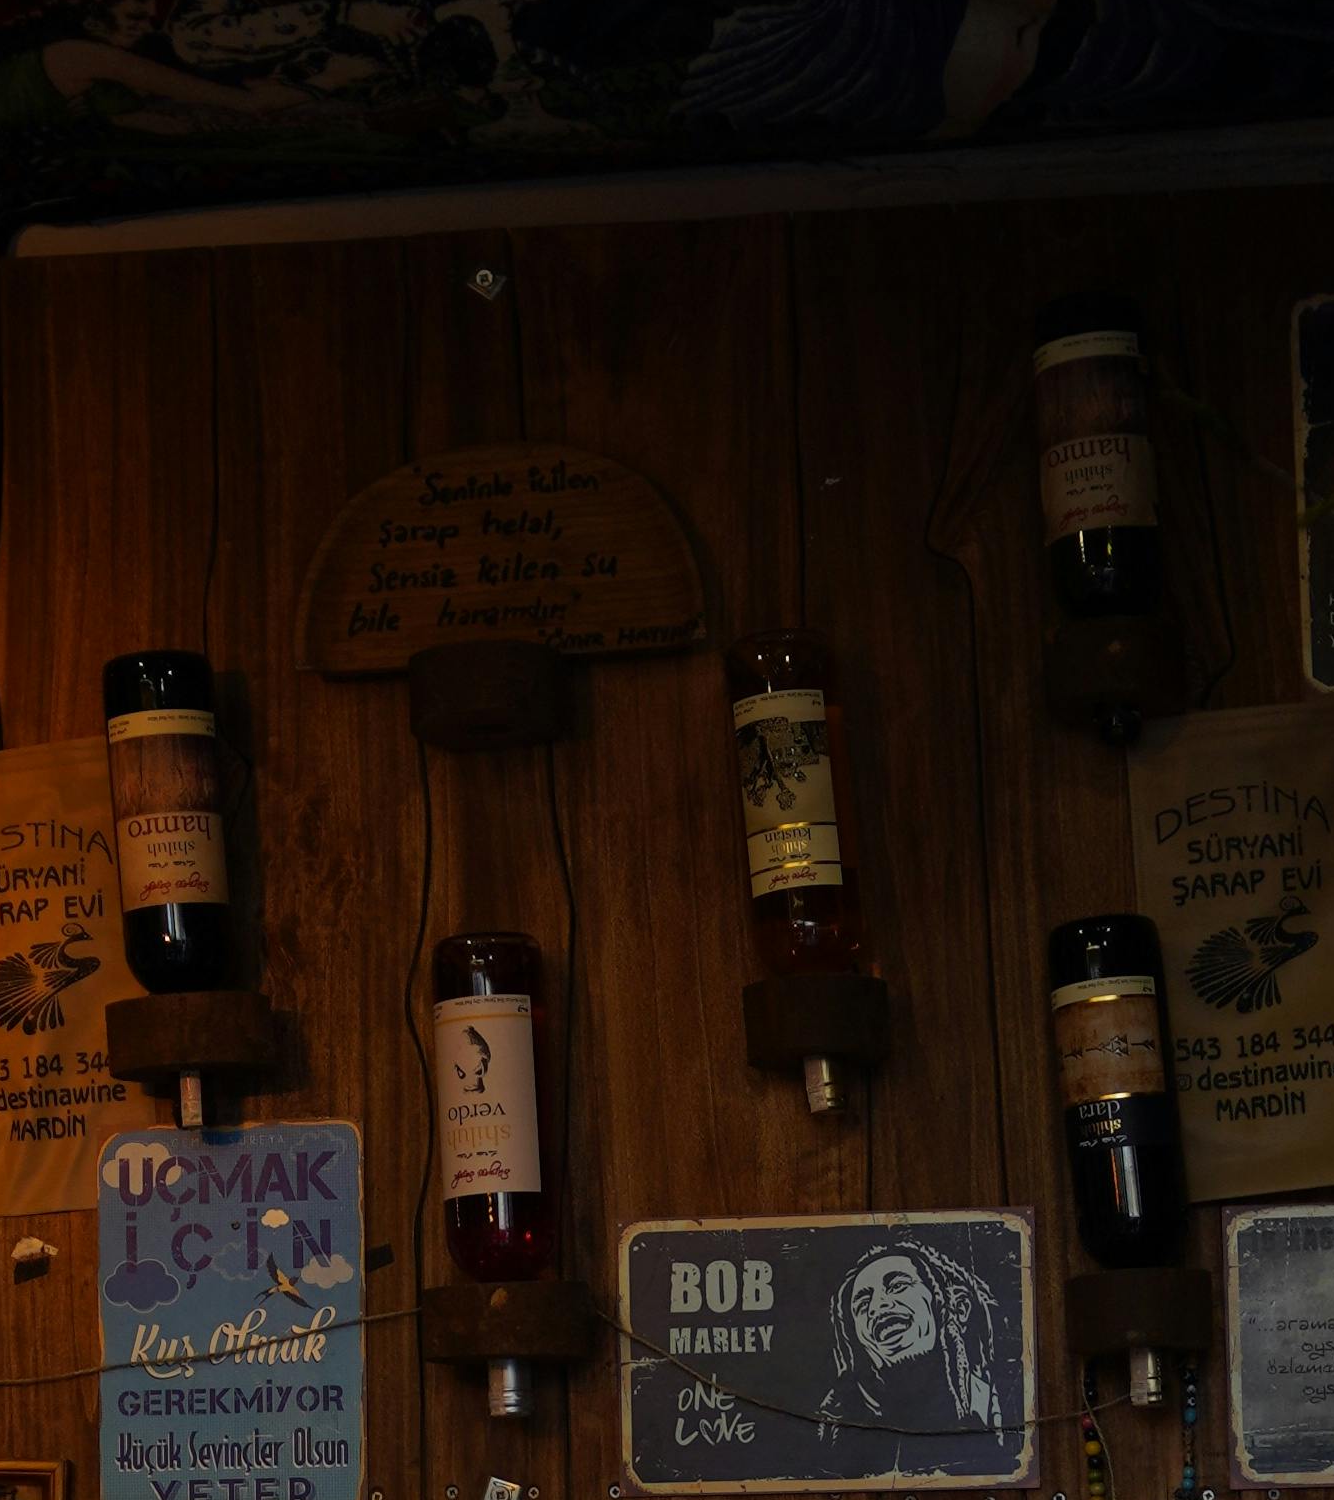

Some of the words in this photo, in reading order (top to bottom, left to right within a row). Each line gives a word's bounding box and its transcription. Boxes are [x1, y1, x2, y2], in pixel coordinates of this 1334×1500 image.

[1041, 436, 1132, 468] hamro
[482, 509, 562, 541] helal,
[347, 601, 402, 638] bile
[127, 814, 213, 841] hamro
[1155, 781, 1331, 844] DESTİNA
[1187, 827, 1304, 865] SÜRYANİ
[1172, 868, 1265, 907] ŞARAP
[1282, 859, 1323, 893] EVİ
[64, 889, 103, 918] EVİ
[1236, 1032, 1281, 1058] 184
[21, 1053, 64, 1080] 184
[447, 1102, 507, 1125] verdo
[1078, 1101, 1121, 1120] dara
[1216, 1086, 1306, 1121] MARDİN
[10, 1109, 86, 1142] MARDİN
[118, 1150, 339, 1222] UÇMAK
[125, 1206, 333, 1290] İÇİN
[669, 1259, 775, 1314] BOB
[130, 1323, 199, 1380] Kuş
[209, 1306, 337, 1366] Olmak
[669, 1325, 775, 1355] MARLEY
[117, 1379, 345, 1417] GEREKMİYOR
[677, 1373, 736, 1412] ONE
[115, 1431, 181, 1480] Küçük
[188, 1427, 285, 1478] Sevinçler
[292, 1426, 349, 1469] Olsun
